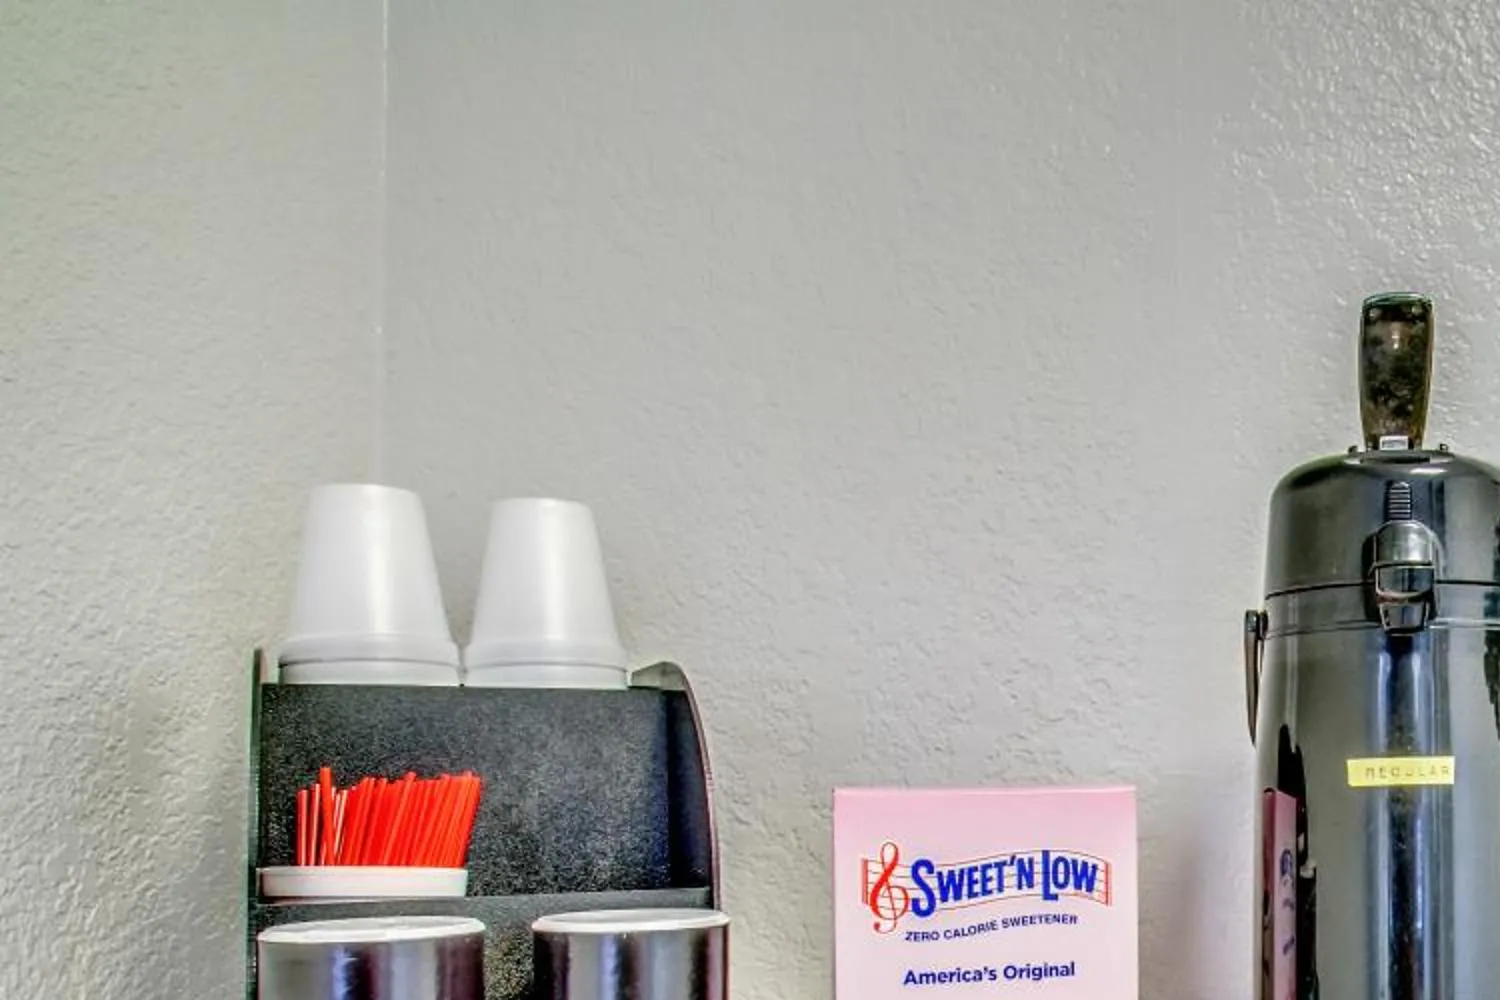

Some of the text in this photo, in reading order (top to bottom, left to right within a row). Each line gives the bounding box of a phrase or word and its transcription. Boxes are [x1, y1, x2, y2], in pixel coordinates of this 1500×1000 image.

[1042, 849, 1098, 901] LOW
[904, 913, 1078, 942] ZERO CALORIE SWEETENER
[903, 961, 1076, 986] America's Original
